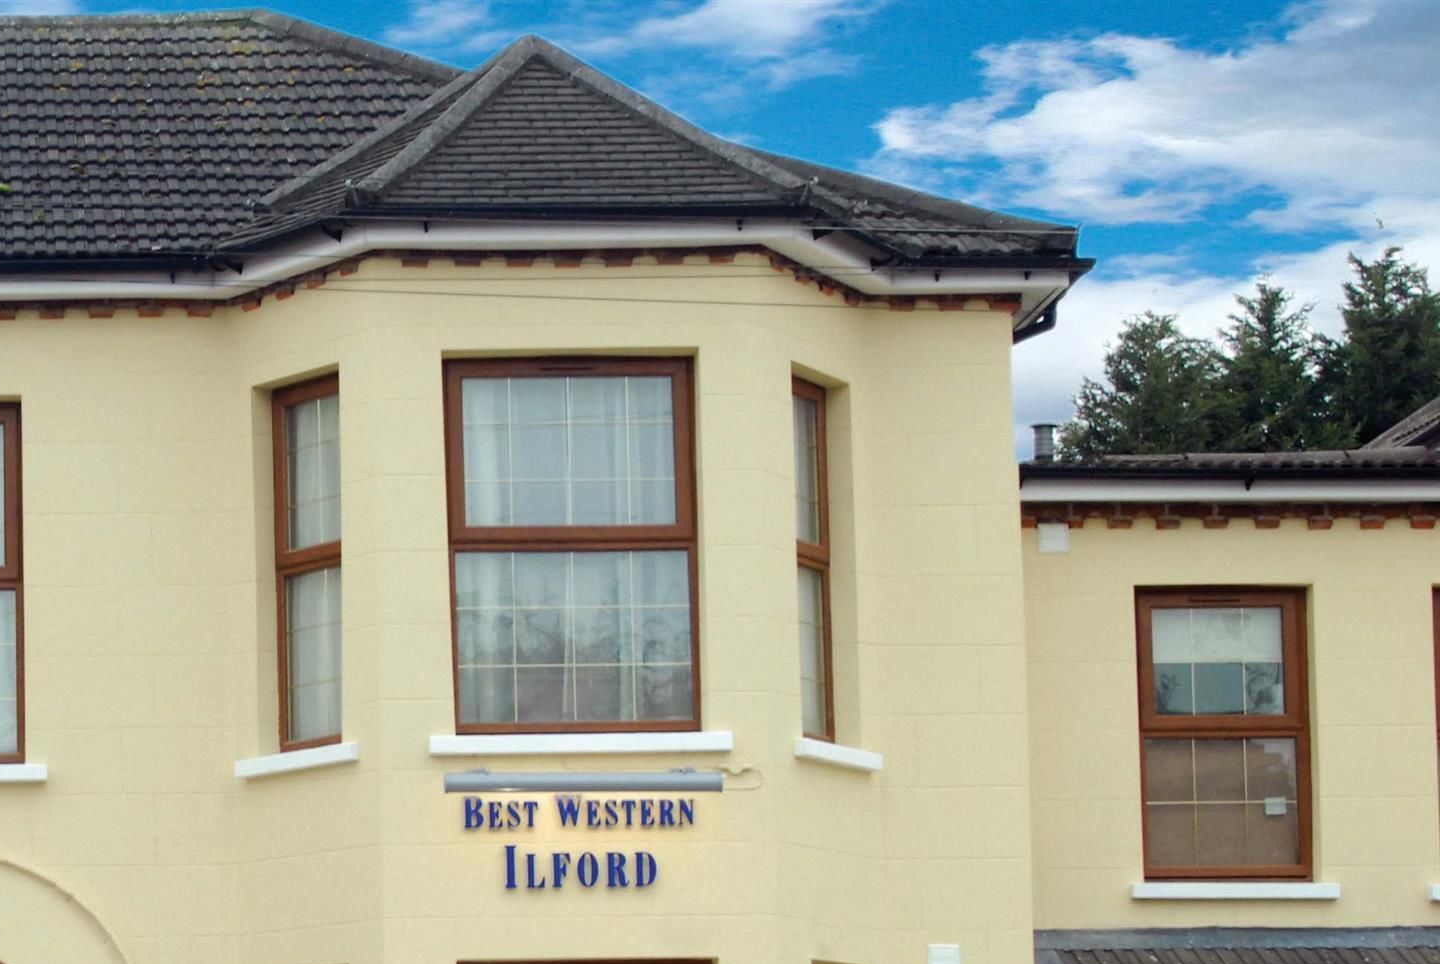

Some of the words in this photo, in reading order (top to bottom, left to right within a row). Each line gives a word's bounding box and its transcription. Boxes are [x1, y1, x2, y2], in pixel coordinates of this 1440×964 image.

[462, 795, 539, 830] BEST
[553, 794, 695, 827] WESTERN
[503, 845, 658, 889] ILFORD
